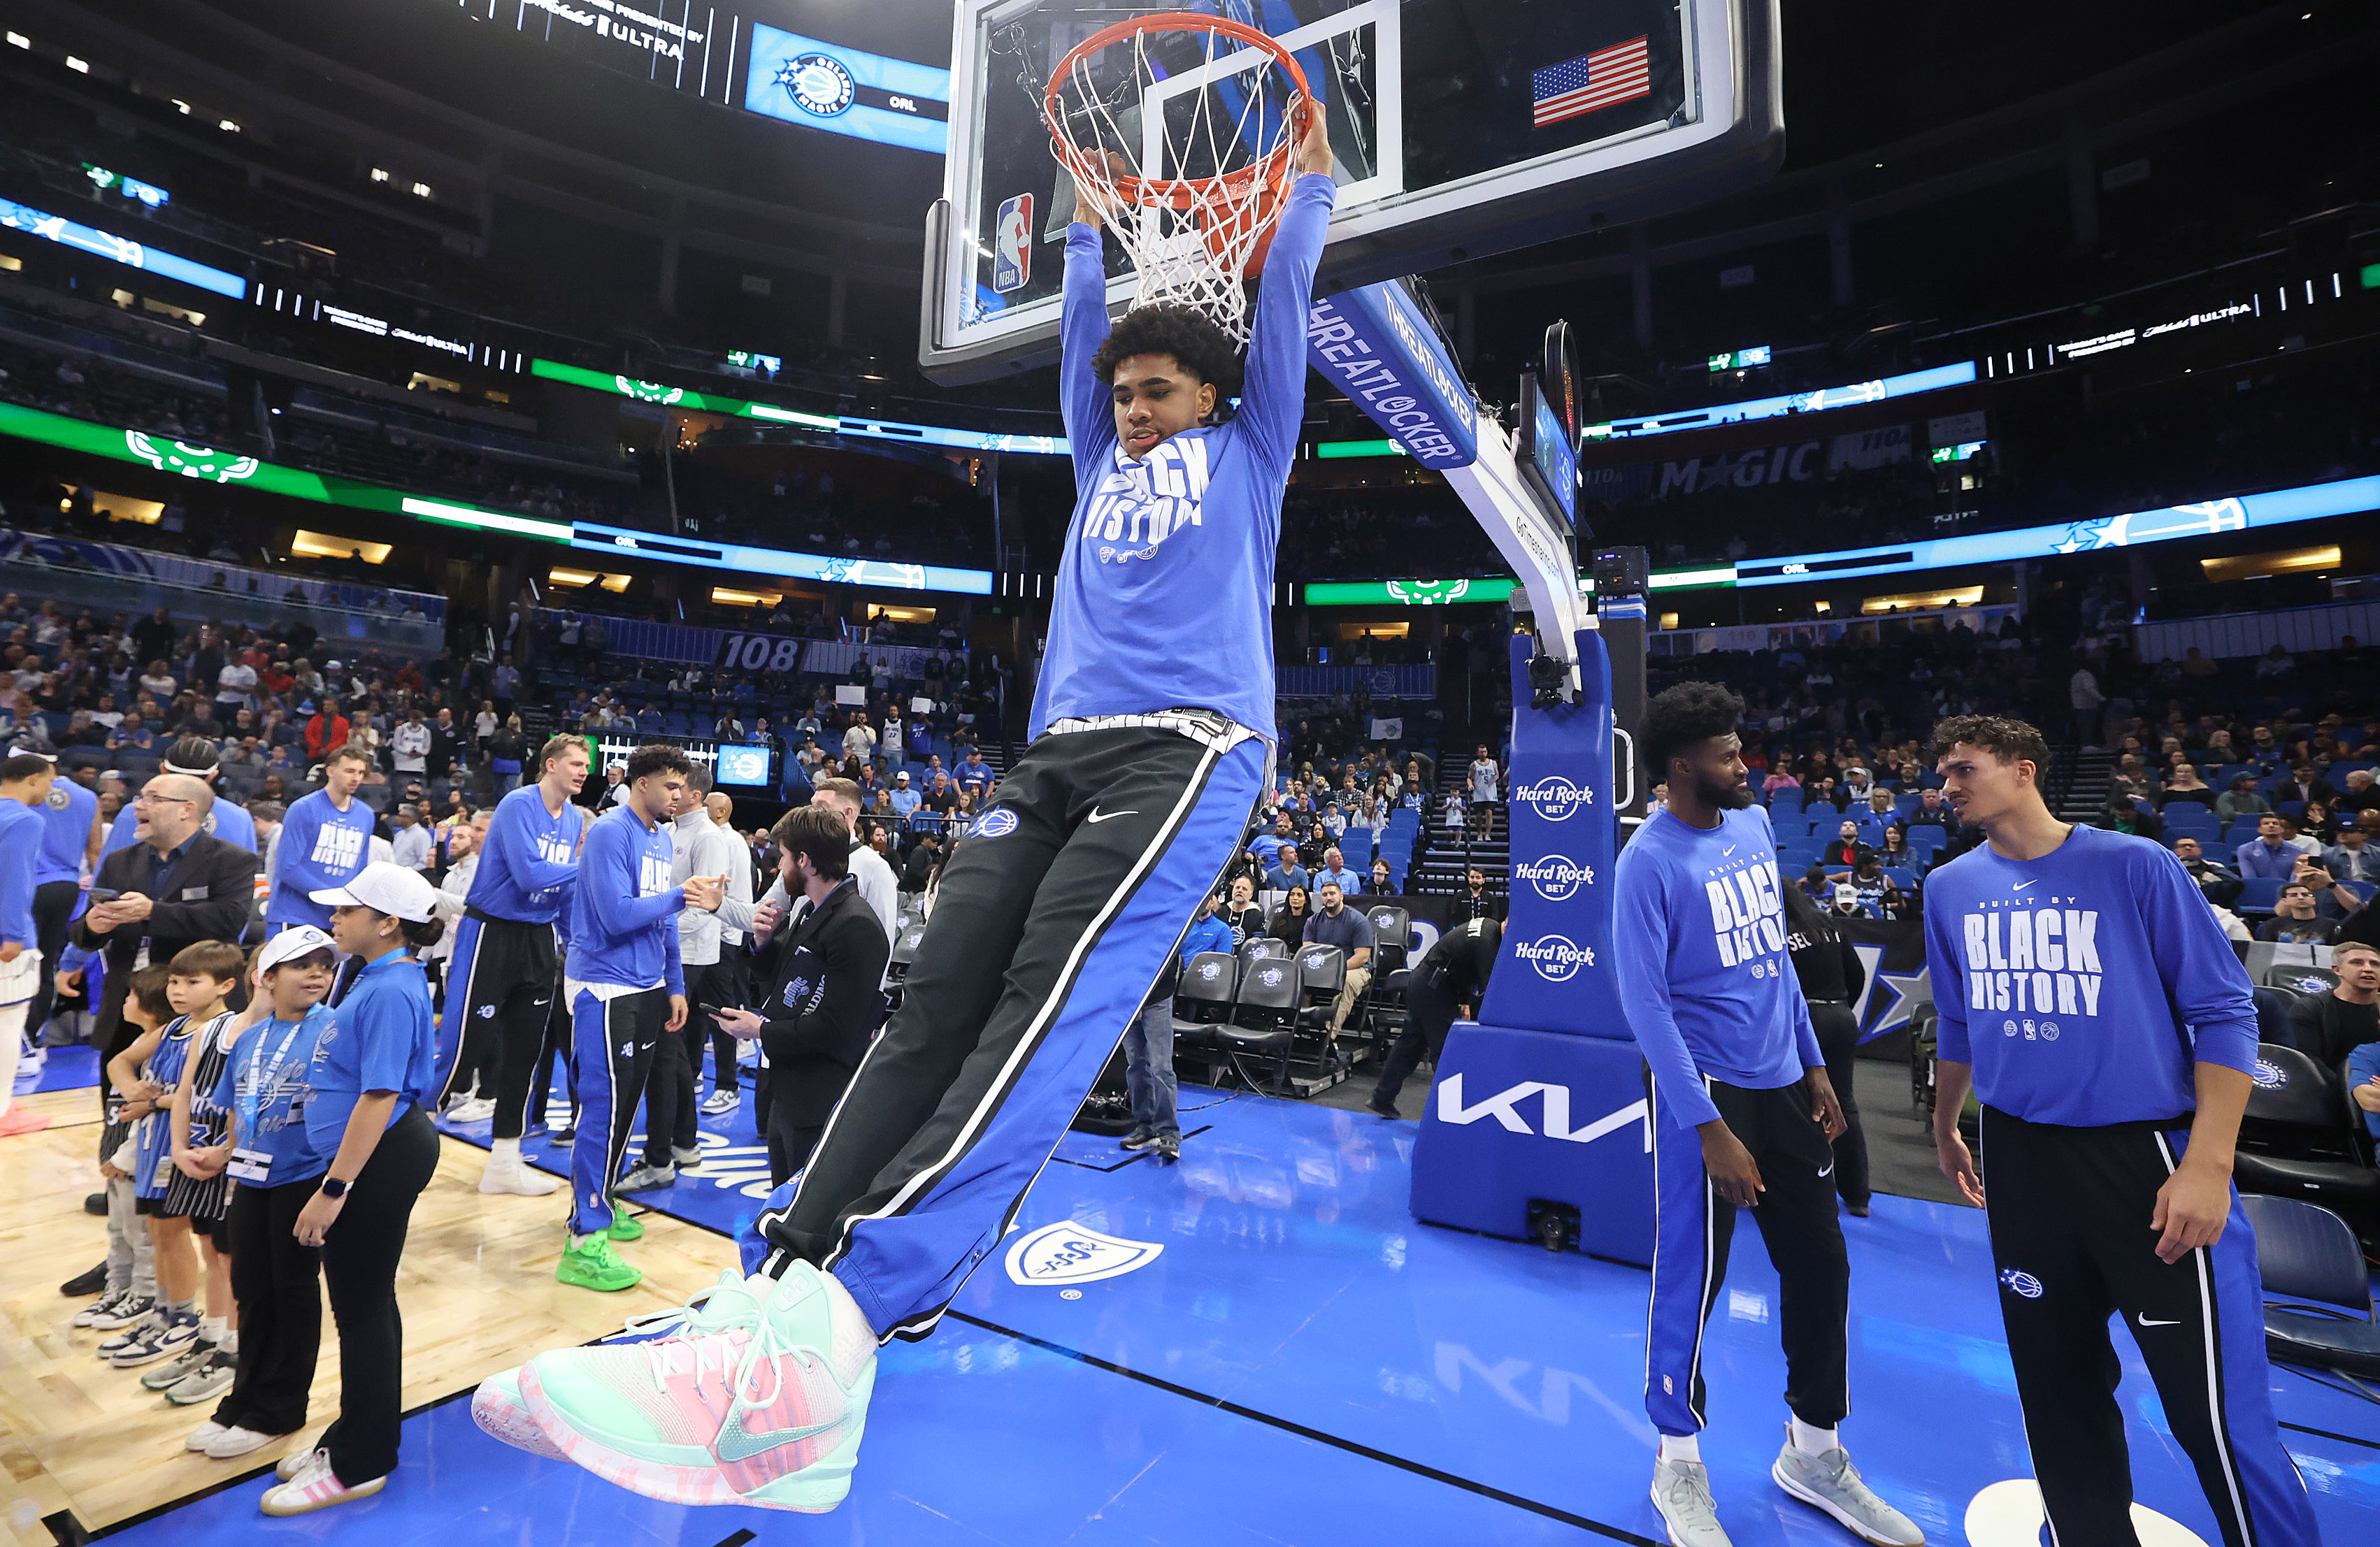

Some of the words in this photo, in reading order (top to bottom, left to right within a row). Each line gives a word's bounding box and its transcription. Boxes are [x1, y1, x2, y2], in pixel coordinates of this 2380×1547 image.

[615, 4, 686, 38] PRESENTED
[687, 29, 704, 43] BY
[612, 22, 684, 61] ULTRA
[817, 57, 851, 104] ORLANDO
[798, 94, 839, 113] MAGIC
[889, 96, 917, 112] ORL
[998, 268, 1016, 287] NBA
[2200, 303, 2252, 323] ULTRA
[433, 338, 468, 355] ULTRA
[1382, 287, 1473, 434] THREATLOCKER
[1307, 298, 1456, 460] HREATLOCKER
[615, 536, 639, 549] ORL
[1782, 563, 1809, 575] ORL
[724, 635, 799, 672] 108
[1516, 785, 1555, 802] Hard
[1556, 786, 1593, 805] Rock
[1545, 805, 1565, 814] BET
[316, 823, 364, 854] BLACK
[1516, 863, 1556, 880] Hard
[1556, 864, 1594, 884] Rock
[1709, 859, 1745, 877] BUILT
[1751, 851, 1765, 861] BY
[1545, 884, 1565, 893] BET
[1979, 897, 2035, 909] BUILT
[2051, 896, 2076, 905] BY
[1963, 908, 2103, 973] BLACK
[1515, 942, 1555, 960] Hard
[1556, 944, 1596, 966] Rock
[1545, 964, 1566, 974] BET
[1970, 971, 2102, 1016] HISTORY
[2256, 1058, 2287, 1083] ORLANDO
